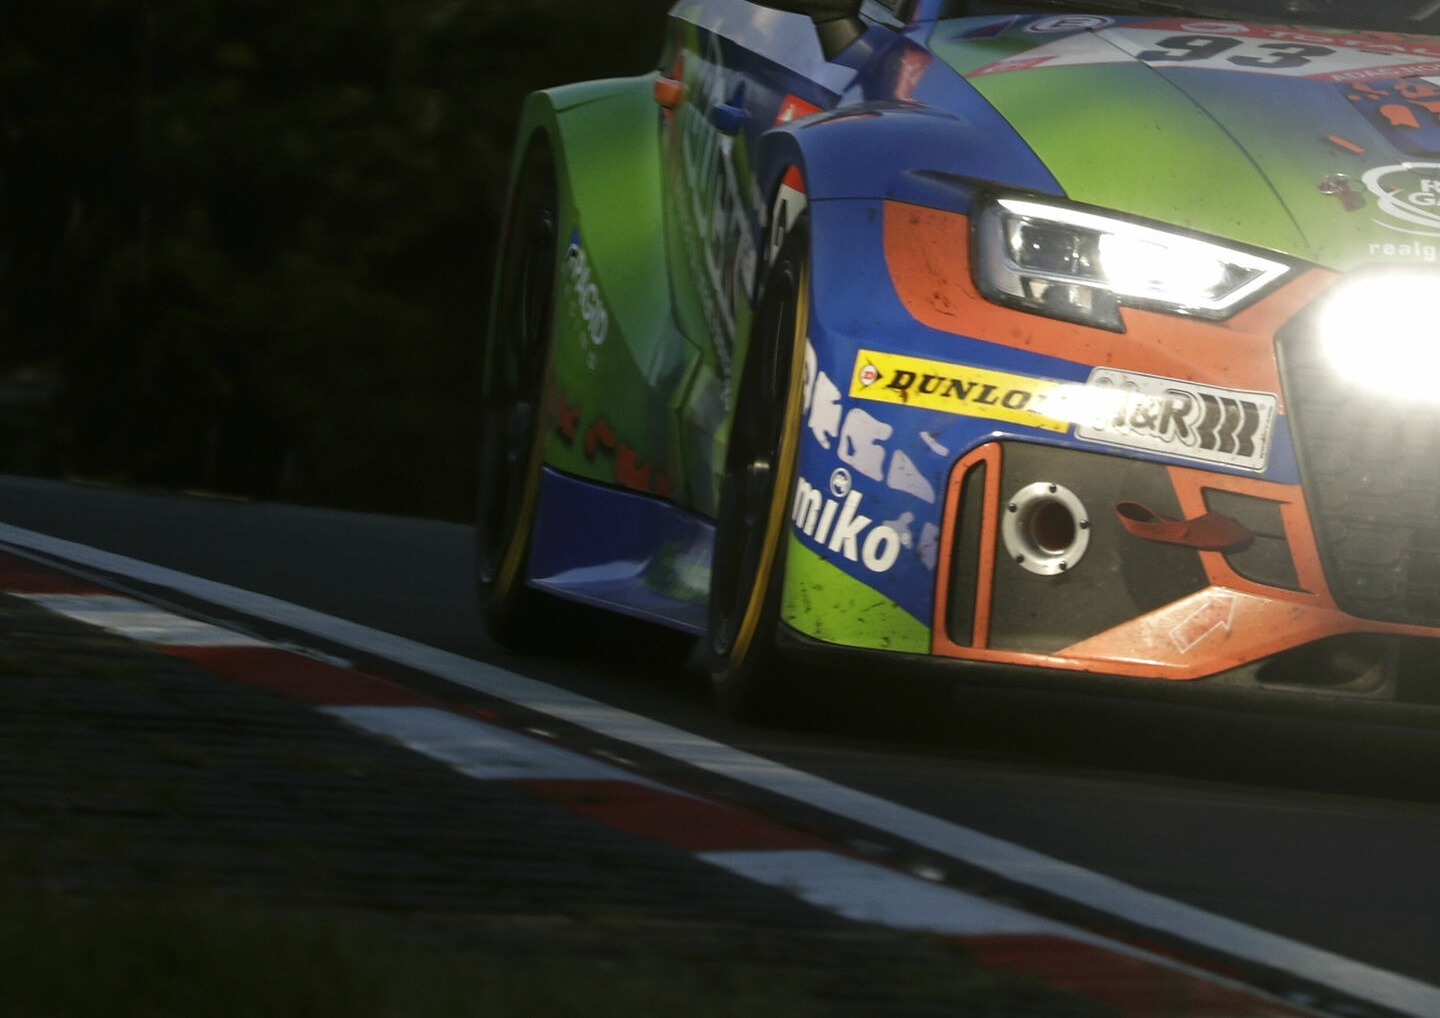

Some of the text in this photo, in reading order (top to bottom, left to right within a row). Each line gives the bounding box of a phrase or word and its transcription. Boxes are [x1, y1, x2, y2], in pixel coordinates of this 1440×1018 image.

[1136, 34, 1337, 69] 93
[886, 368, 1062, 416] DUNLO
[791, 466, 902, 573] miko
